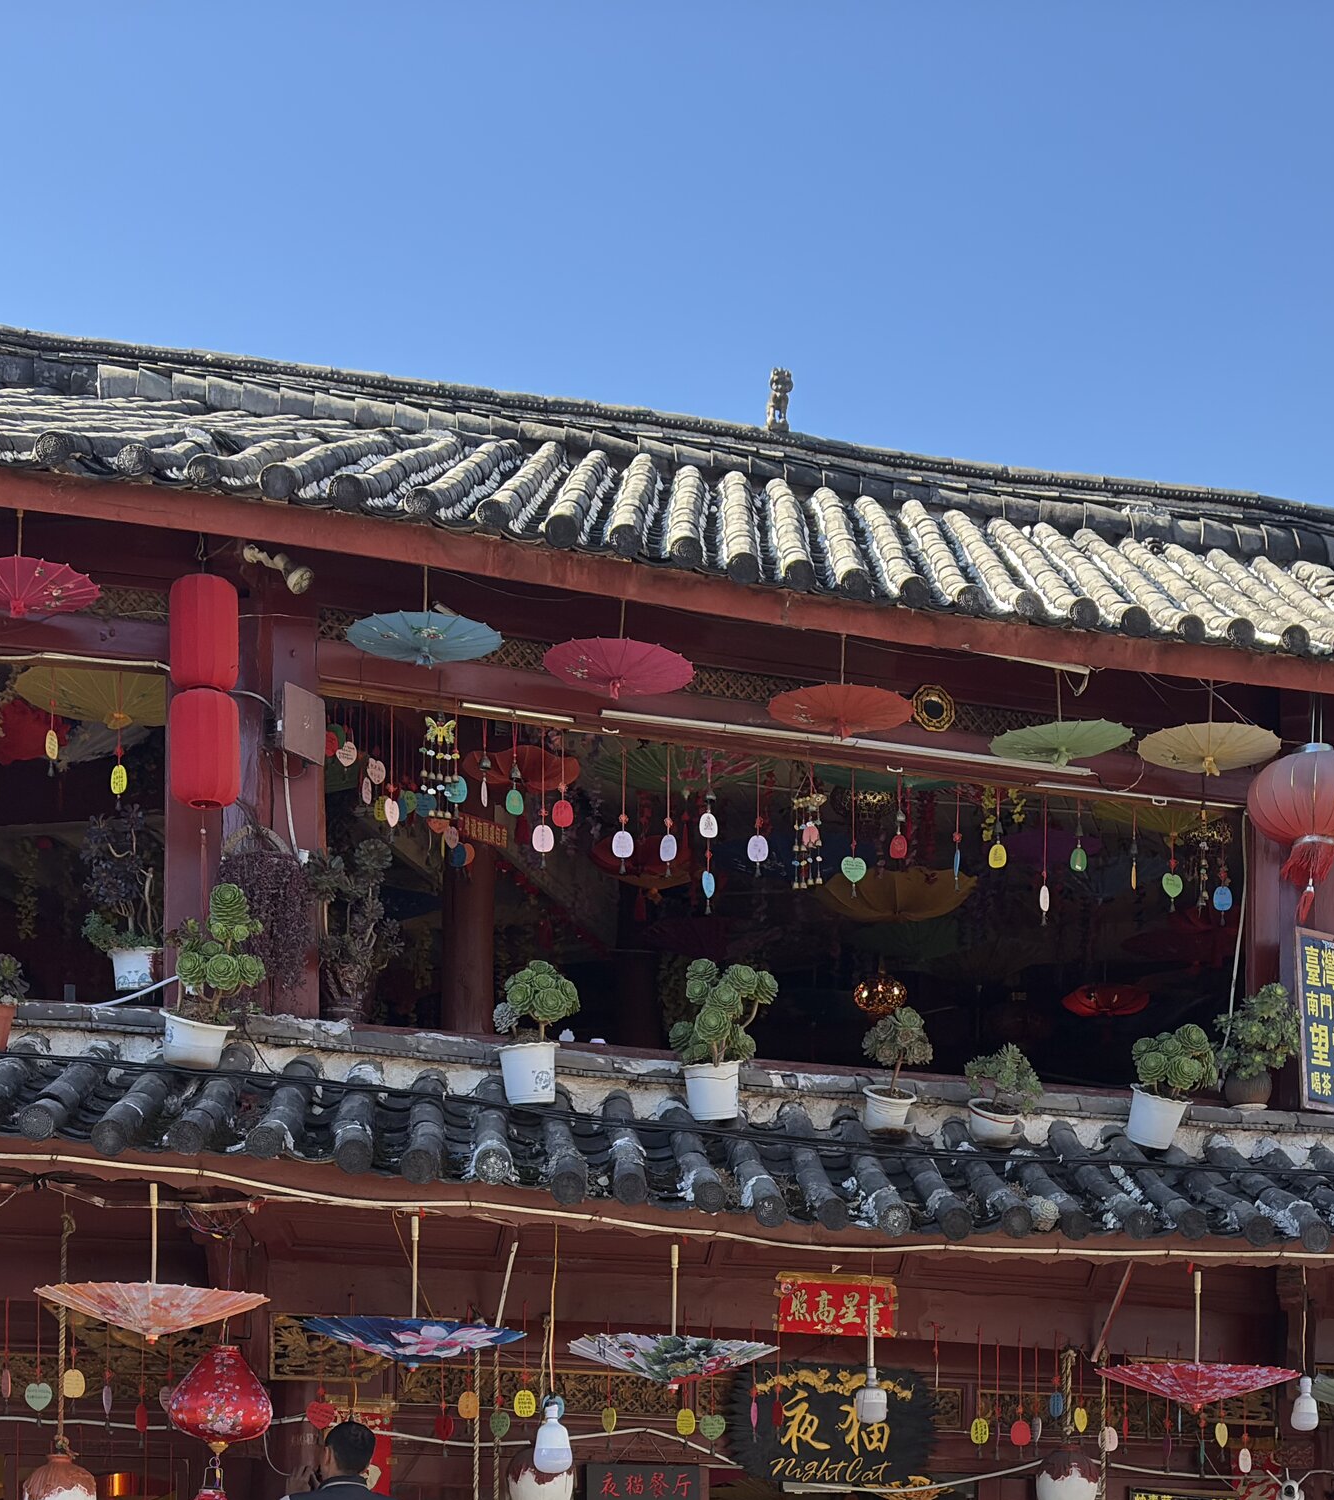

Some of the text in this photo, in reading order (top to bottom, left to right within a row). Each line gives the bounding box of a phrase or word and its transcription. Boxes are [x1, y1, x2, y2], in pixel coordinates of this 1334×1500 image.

[1311, 1071, 1332, 1097] 喝茶
[781, 1389, 890, 1456] 夜猫
[600, 1472, 692, 1498] 夜猫餐厅
